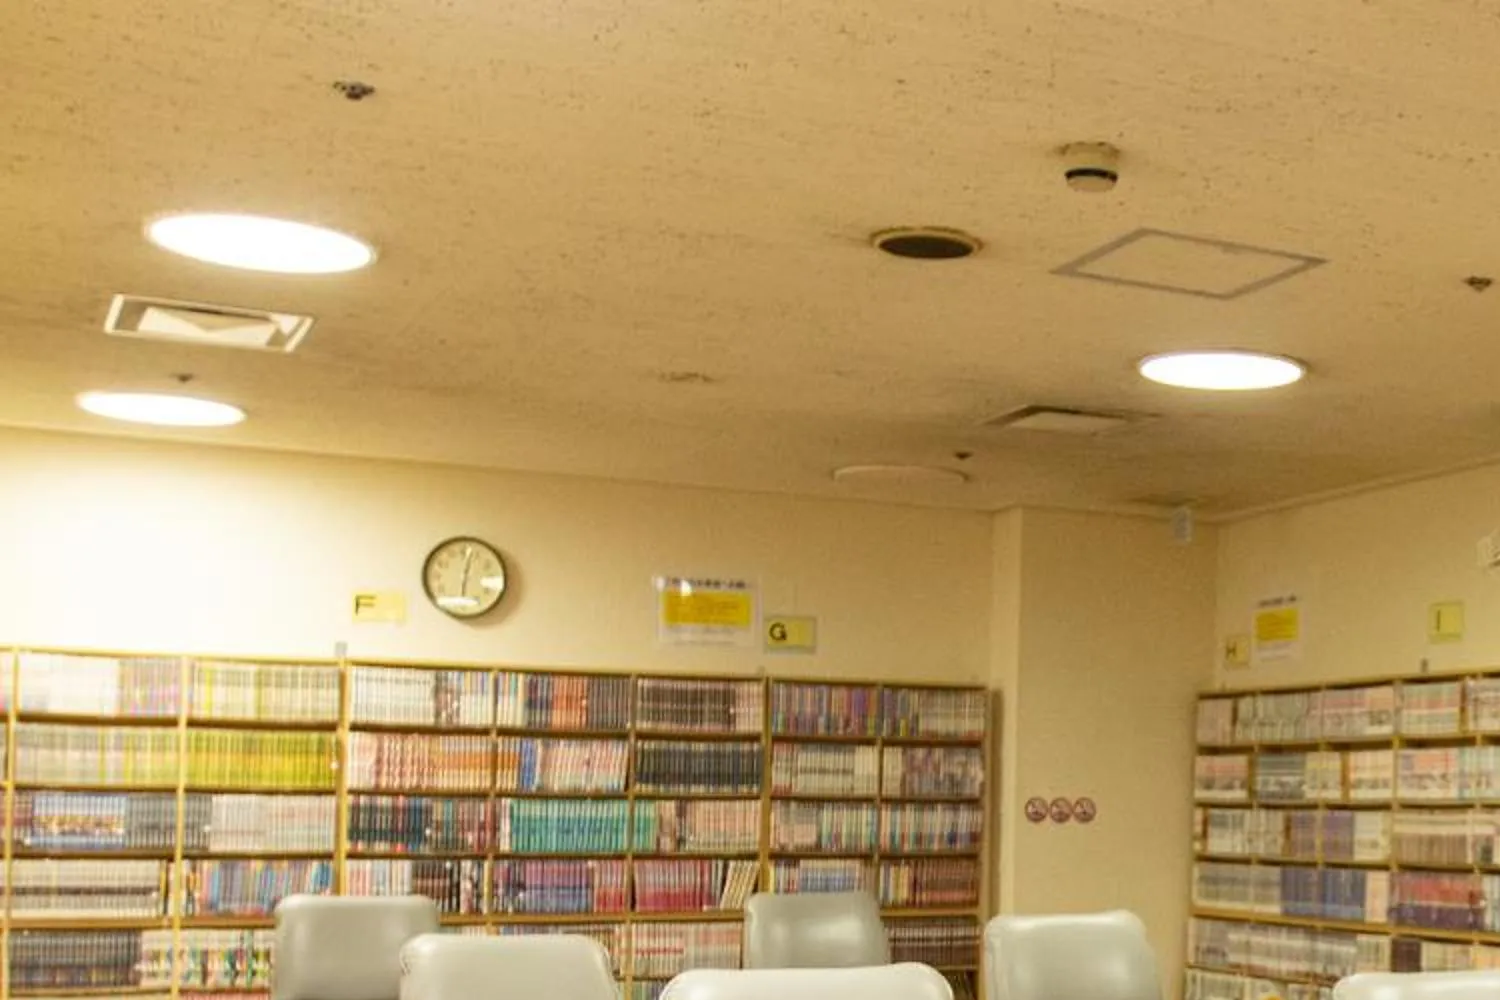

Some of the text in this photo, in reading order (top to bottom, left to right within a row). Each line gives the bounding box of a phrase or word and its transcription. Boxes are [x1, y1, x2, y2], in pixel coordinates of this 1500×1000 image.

[355, 594, 377, 616] F
[769, 622, 787, 641] G
[1225, 641, 1238, 660] H
